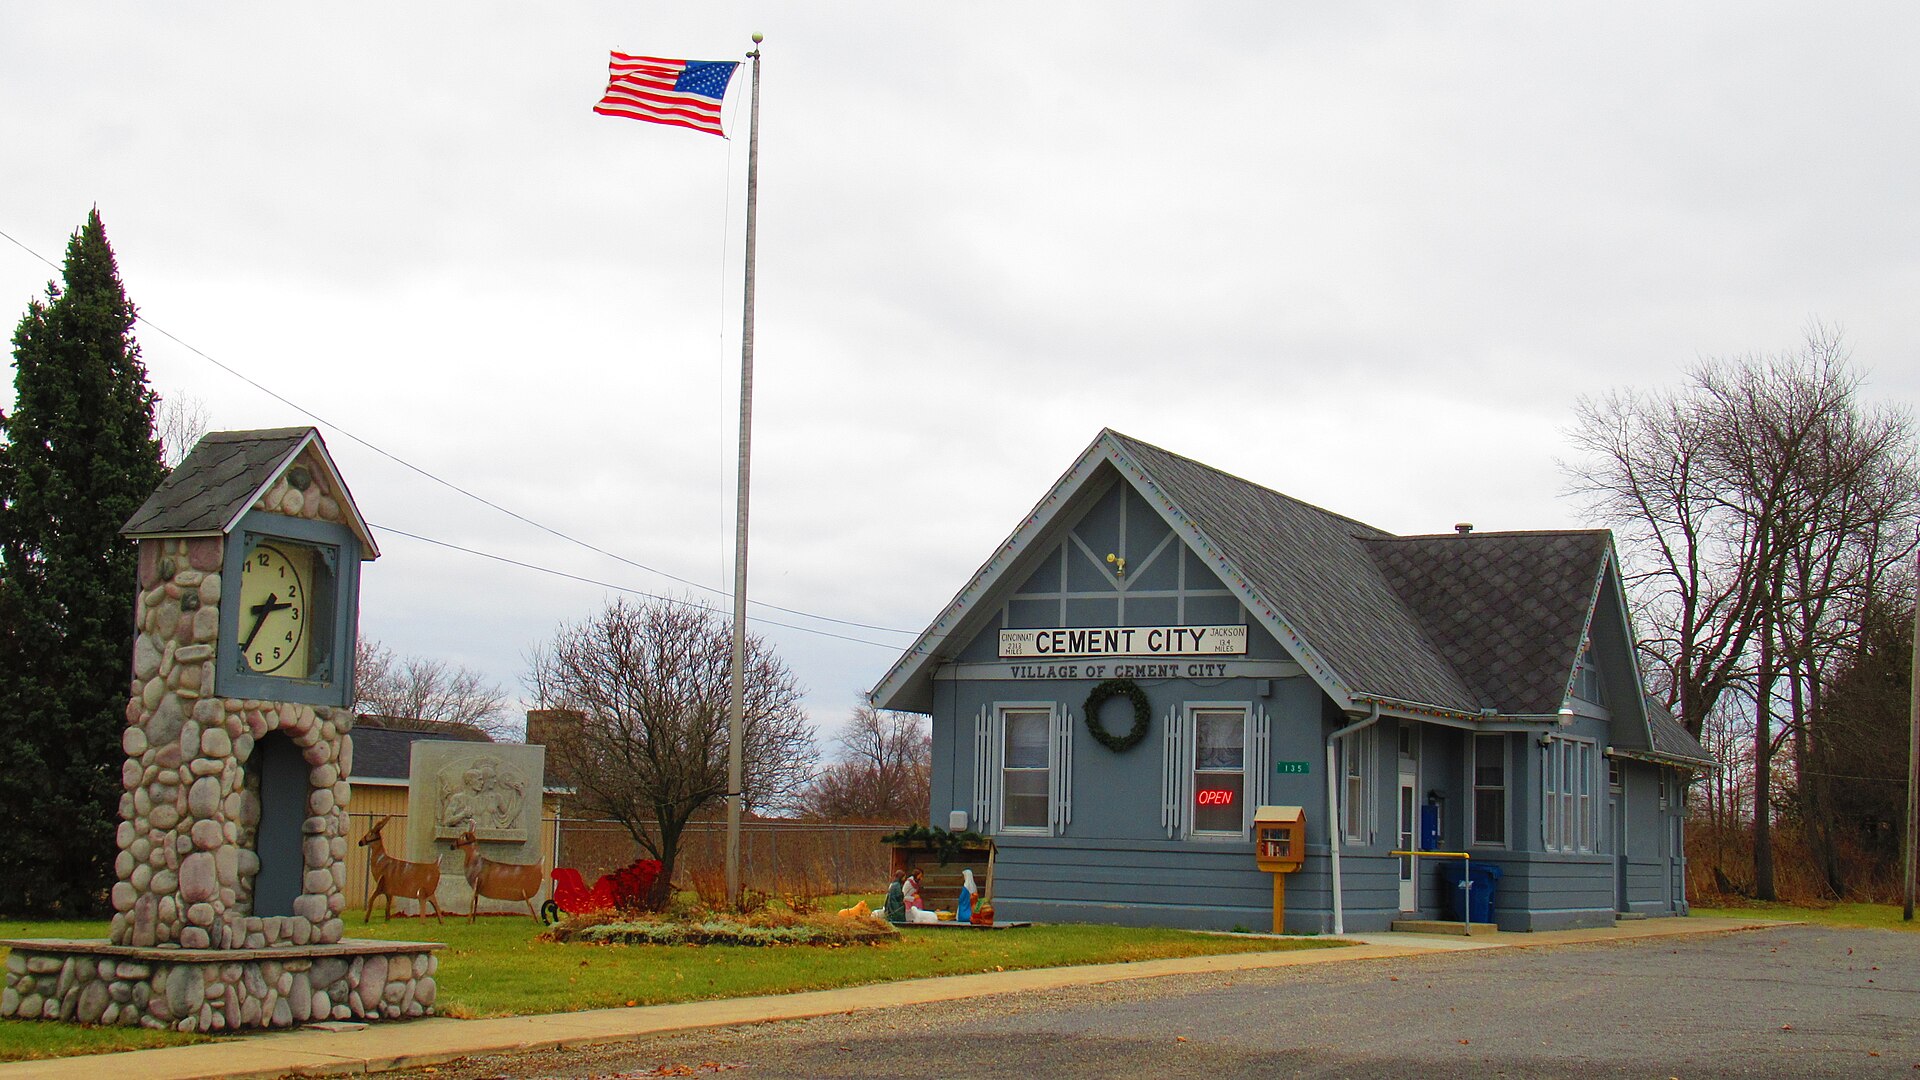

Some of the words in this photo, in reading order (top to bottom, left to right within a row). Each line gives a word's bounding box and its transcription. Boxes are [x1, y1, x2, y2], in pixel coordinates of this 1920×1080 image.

[257, 553, 269, 567] 12
[278, 566, 285, 578] 1
[288, 585, 296, 598] 2
[291, 607, 299, 620] 3
[285, 630, 293, 643] 4
[1001, 633, 1034, 641] CINCINNATI
[1210, 627, 1245, 637] JACKSON
[1036, 630, 1136, 653] CEMENT
[1148, 629, 1206, 652] CITY
[255, 653, 263, 665] 6
[273, 646, 281, 660] 5
[1012, 666, 1078, 678] VILLAGE
[1085, 665, 1106, 678] OF
[1114, 664, 1179, 678] CEMENT
[1187, 663, 1227, 677] CITY
[1284, 764, 1302, 773] 135
[1198, 791, 1233, 804] OPEN
